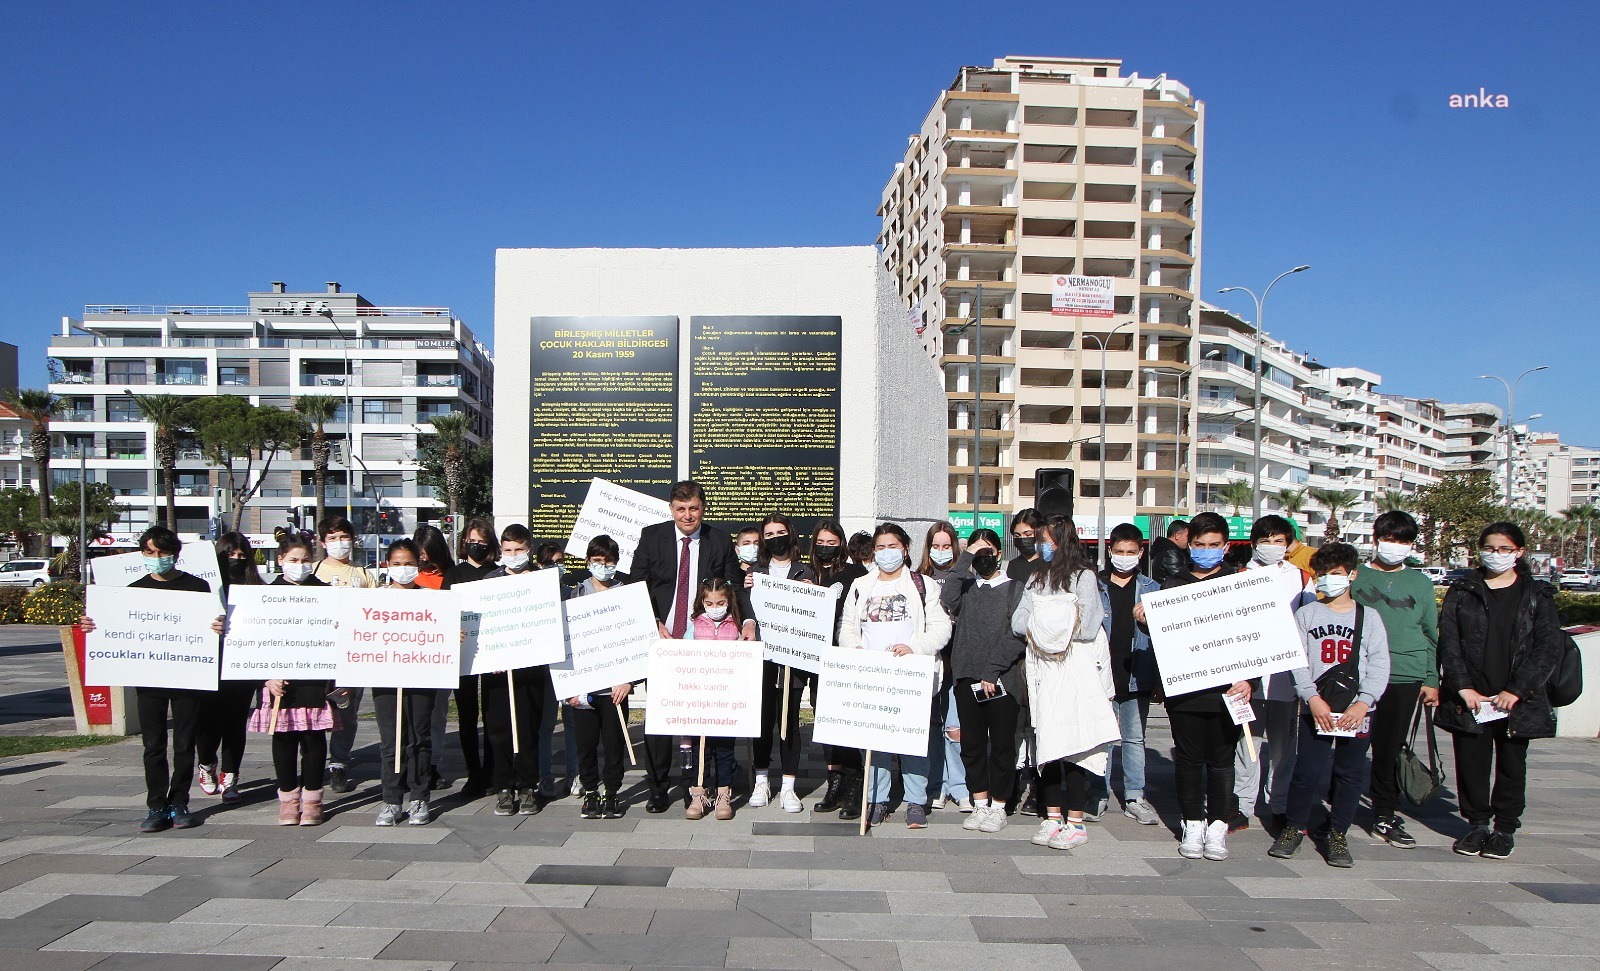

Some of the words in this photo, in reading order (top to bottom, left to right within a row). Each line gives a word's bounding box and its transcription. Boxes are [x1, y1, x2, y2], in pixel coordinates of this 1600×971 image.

[554, 330, 601, 339] BİRLEŞMİŞ
[540, 340, 572, 350] ÇOCUK
[618, 339, 668, 347] BİLDİRGESİ
[600, 490, 612, 500] Hiç
[614, 496, 636, 508] kimse
[598, 507, 633, 523] onurunu
[580, 517, 601, 529] onları
[603, 524, 625, 538] küçük
[980, 517, 1000, 528] Yaşa
[125, 566, 142, 574] Her
[497, 588, 531, 601] çocuğun
[762, 578, 771, 589] Hiç
[773, 581, 790, 591] kimse
[792, 586, 825, 598] çocukların
[262, 595, 286, 604] Çocuk
[1151, 594, 1189, 609] Herkesin
[1192, 585, 1232, 601] çocukları
[482, 606, 522, 618] ortamında
[524, 601, 556, 613] yaşama
[764, 601, 789, 612] onurunu
[128, 611, 160, 622] Hiçbir
[164, 613, 181, 624] kişi
[269, 617, 303, 626] çocuklar
[362, 608, 437, 624] Yaşamak,
[566, 611, 591, 624] Çocuk
[1161, 620, 1192, 632] onların
[1194, 609, 1233, 625] fikirlerini
[1236, 601, 1276, 616] öğrenme
[470, 623, 519, 637] savaşlardan
[522, 617, 556, 628] korunma
[582, 625, 612, 638] çocuklar
[771, 622, 789, 634] küçük
[1308, 624, 1354, 639] VARSIT
[105, 630, 135, 640] kendi
[139, 631, 182, 642] çıkarları
[186, 634, 203, 644] için
[227, 639, 255, 648] Doğum
[354, 629, 378, 641] her
[383, 630, 444, 645] çocuğun
[603, 635, 648, 649] konuştukları
[1189, 644, 1200, 652] ve
[1202, 637, 1234, 650] onların
[1236, 631, 1261, 644] saygı
[486, 640, 507, 651] hakkı
[657, 648, 701, 657] Çocukların
[704, 649, 726, 657] okula
[765, 641, 790, 654] hayatına
[792, 648, 820, 661] karışama
[1321, 639, 1352, 664] 86
[89, 650, 145, 660] çocukları
[149, 651, 216, 664] kullanamaz.
[347, 650, 387, 662] temel
[393, 651, 454, 664] hakkıdır.
[570, 666, 592, 677] olursa
[594, 660, 614, 670] olsun
[616, 655, 629, 665] fark
[632, 652, 649, 661] etme
[824, 661, 856, 670] Herkesin
[858, 665, 891, 674] çocukları
[1166, 669, 1208, 685] gösterme
[1210, 656, 1268, 675] sorumluluğu
[1270, 649, 1300, 662] vardır.
[826, 680, 851, 688] onların
[854, 682, 884, 692] fikirlerini
[887, 686, 921, 696] öğrenme
[687, 699, 729, 709] yetişkinler
[732, 701, 746, 710] gibi
[853, 702, 876, 710] onlara
[879, 705, 901, 714] saygı
[817, 715, 851, 726] gösterme
[854, 720, 900, 733] sorumluluğu
